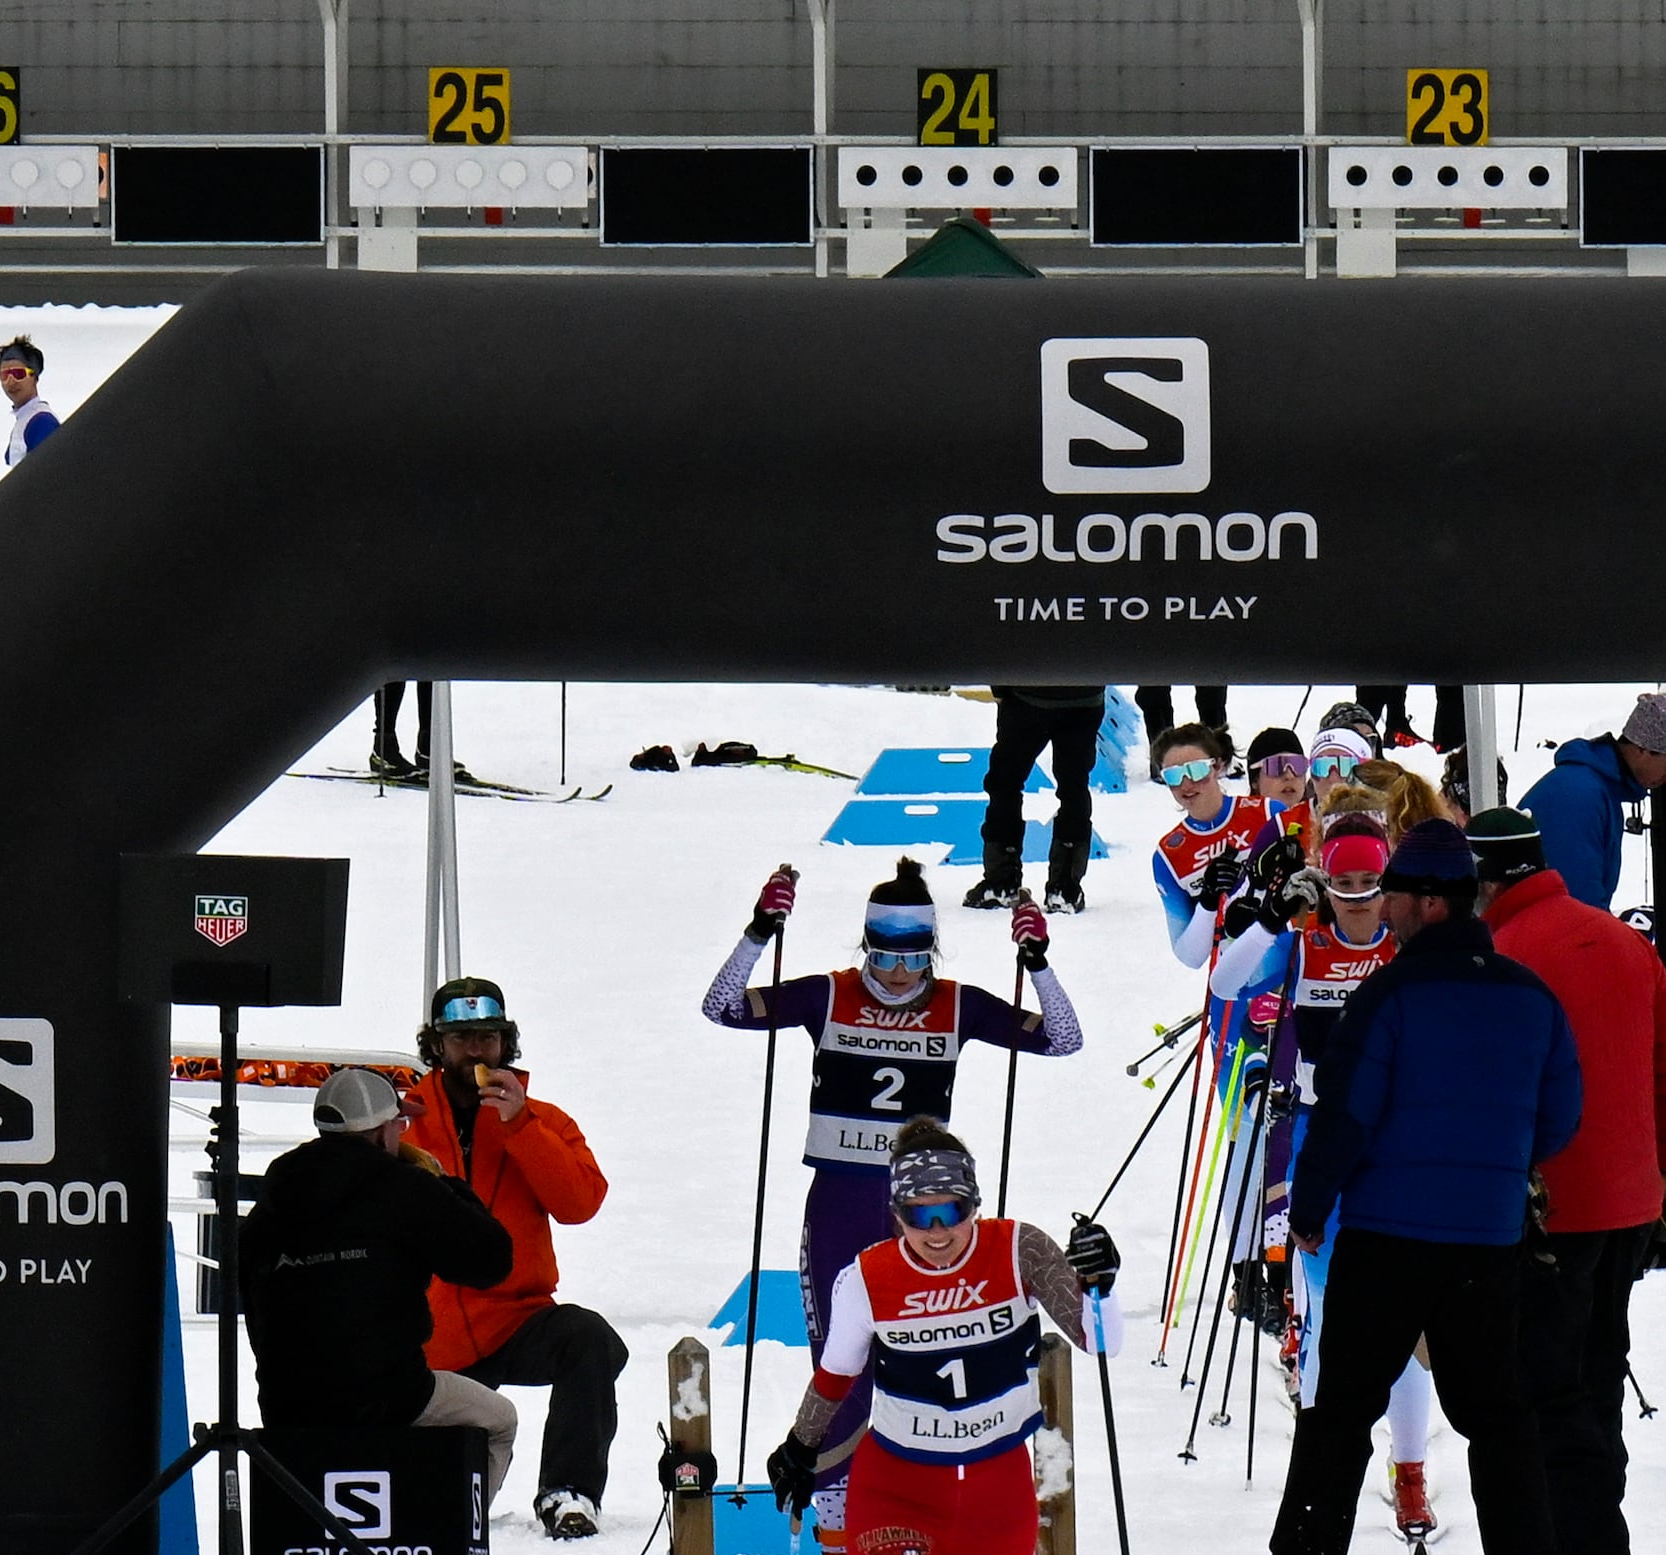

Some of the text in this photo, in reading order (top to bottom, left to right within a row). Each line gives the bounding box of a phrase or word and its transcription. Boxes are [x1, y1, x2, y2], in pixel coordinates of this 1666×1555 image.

[433, 72, 506, 144] 25
[920, 74, 995, 145] 24
[1410, 73, 1484, 145] 23
[936, 511, 1318, 563] salomon
[994, 596, 1258, 622] TIME TO PLAY
[199, 899, 243, 916] TAG
[198, 919, 244, 943] HEUER
[1309, 989, 1357, 1001] salo
[870, 1067, 906, 1112] 2
[839, 1129, 897, 1153] L.L.Be
[20, 1259, 92, 1284] PLAY
[936, 1358, 968, 1400] 1
[911, 1409, 1005, 1439] L.L.Bean
